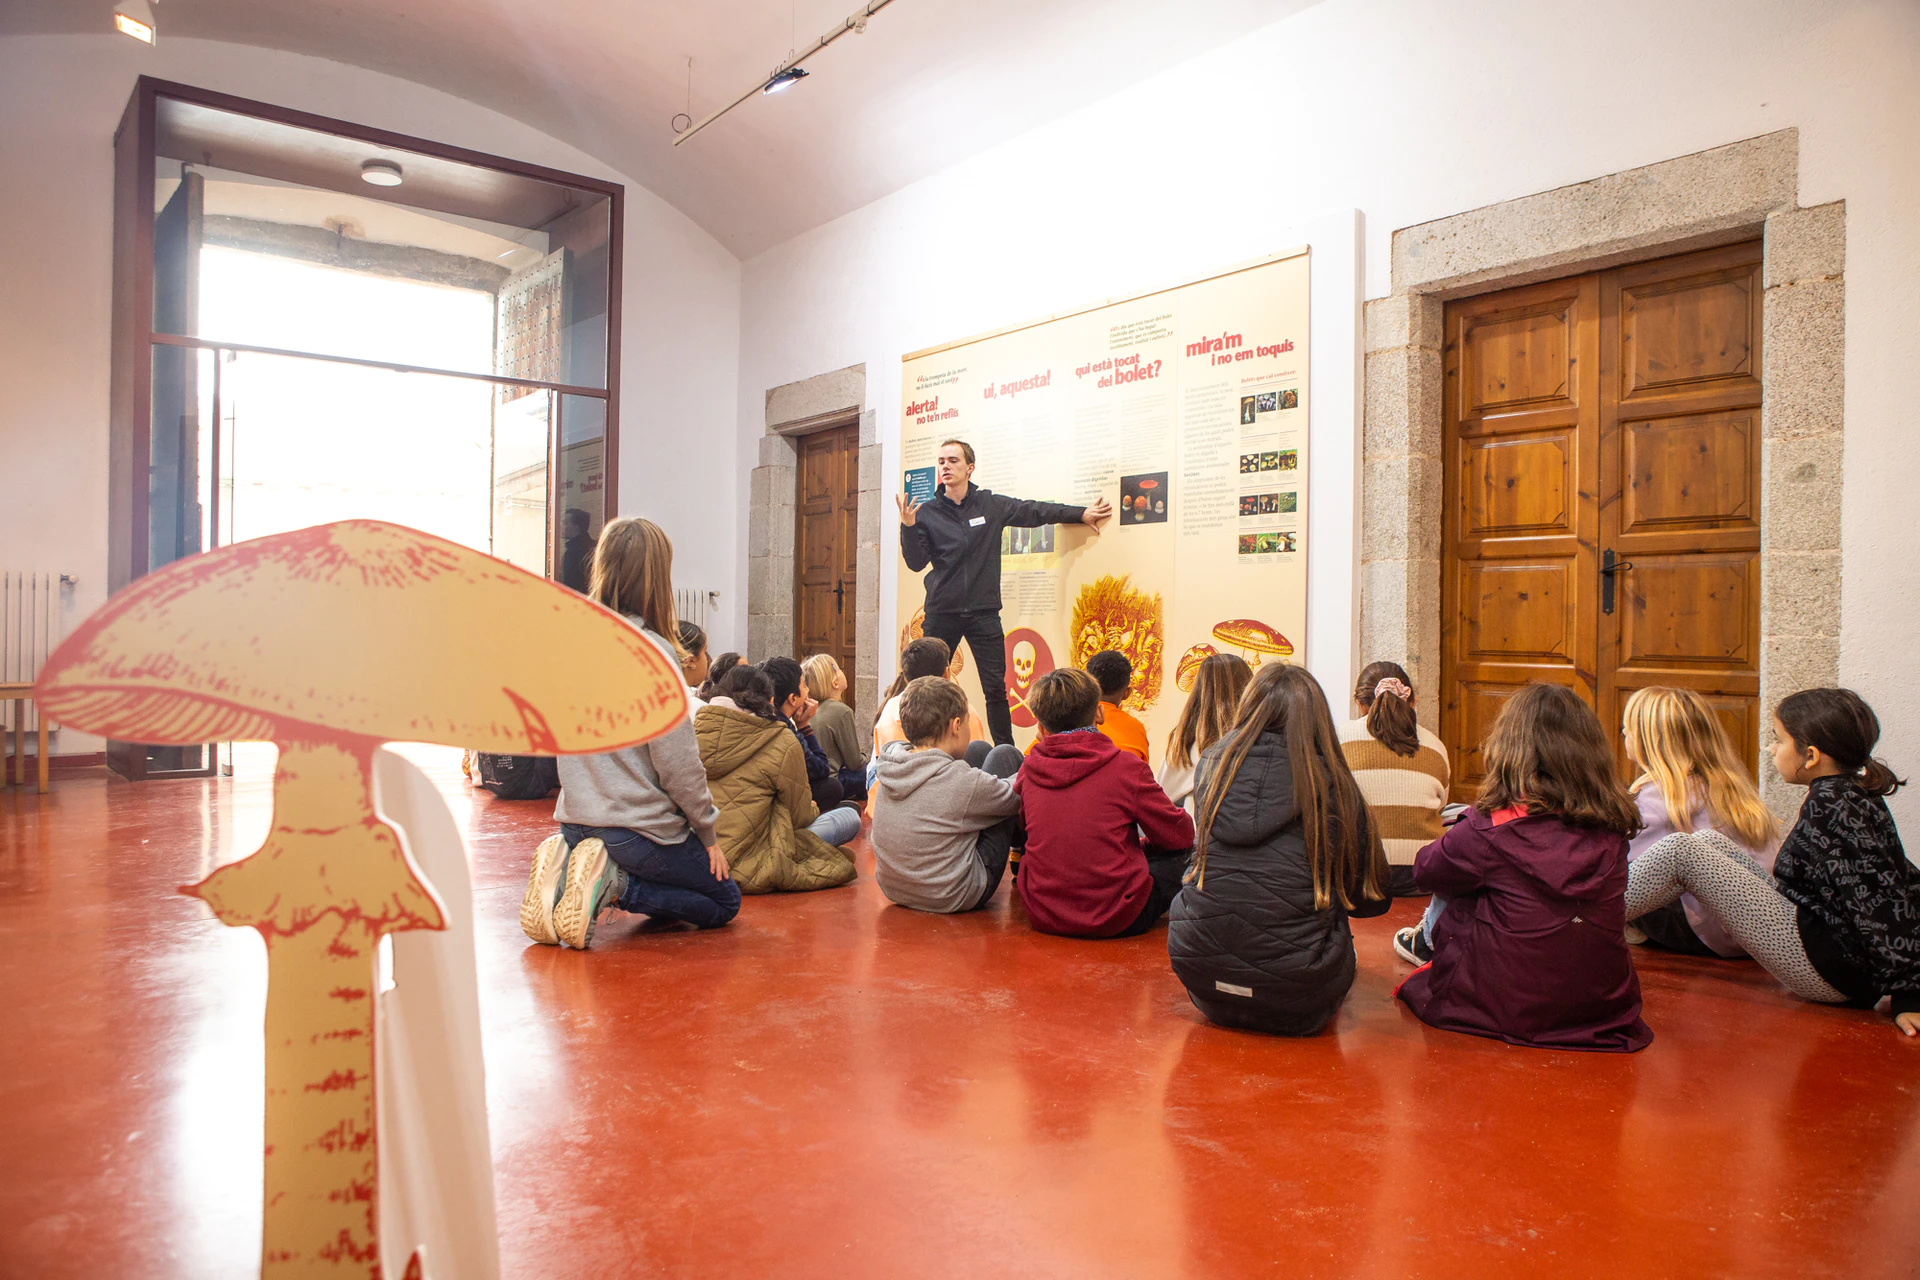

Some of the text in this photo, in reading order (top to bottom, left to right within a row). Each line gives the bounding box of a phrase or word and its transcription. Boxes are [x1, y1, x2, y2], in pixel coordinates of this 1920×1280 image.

[1211, 338, 1294, 366] i no em toquis
[1075, 353, 1140, 379] qui està tocat
[1097, 359, 1162, 389] del bolet?
[983, 370, 1051, 399] ui, aquesta!
[906, 395, 939, 417] alerta!
[916, 416, 926, 425] no
[1825, 858, 1876, 875] DANCE
